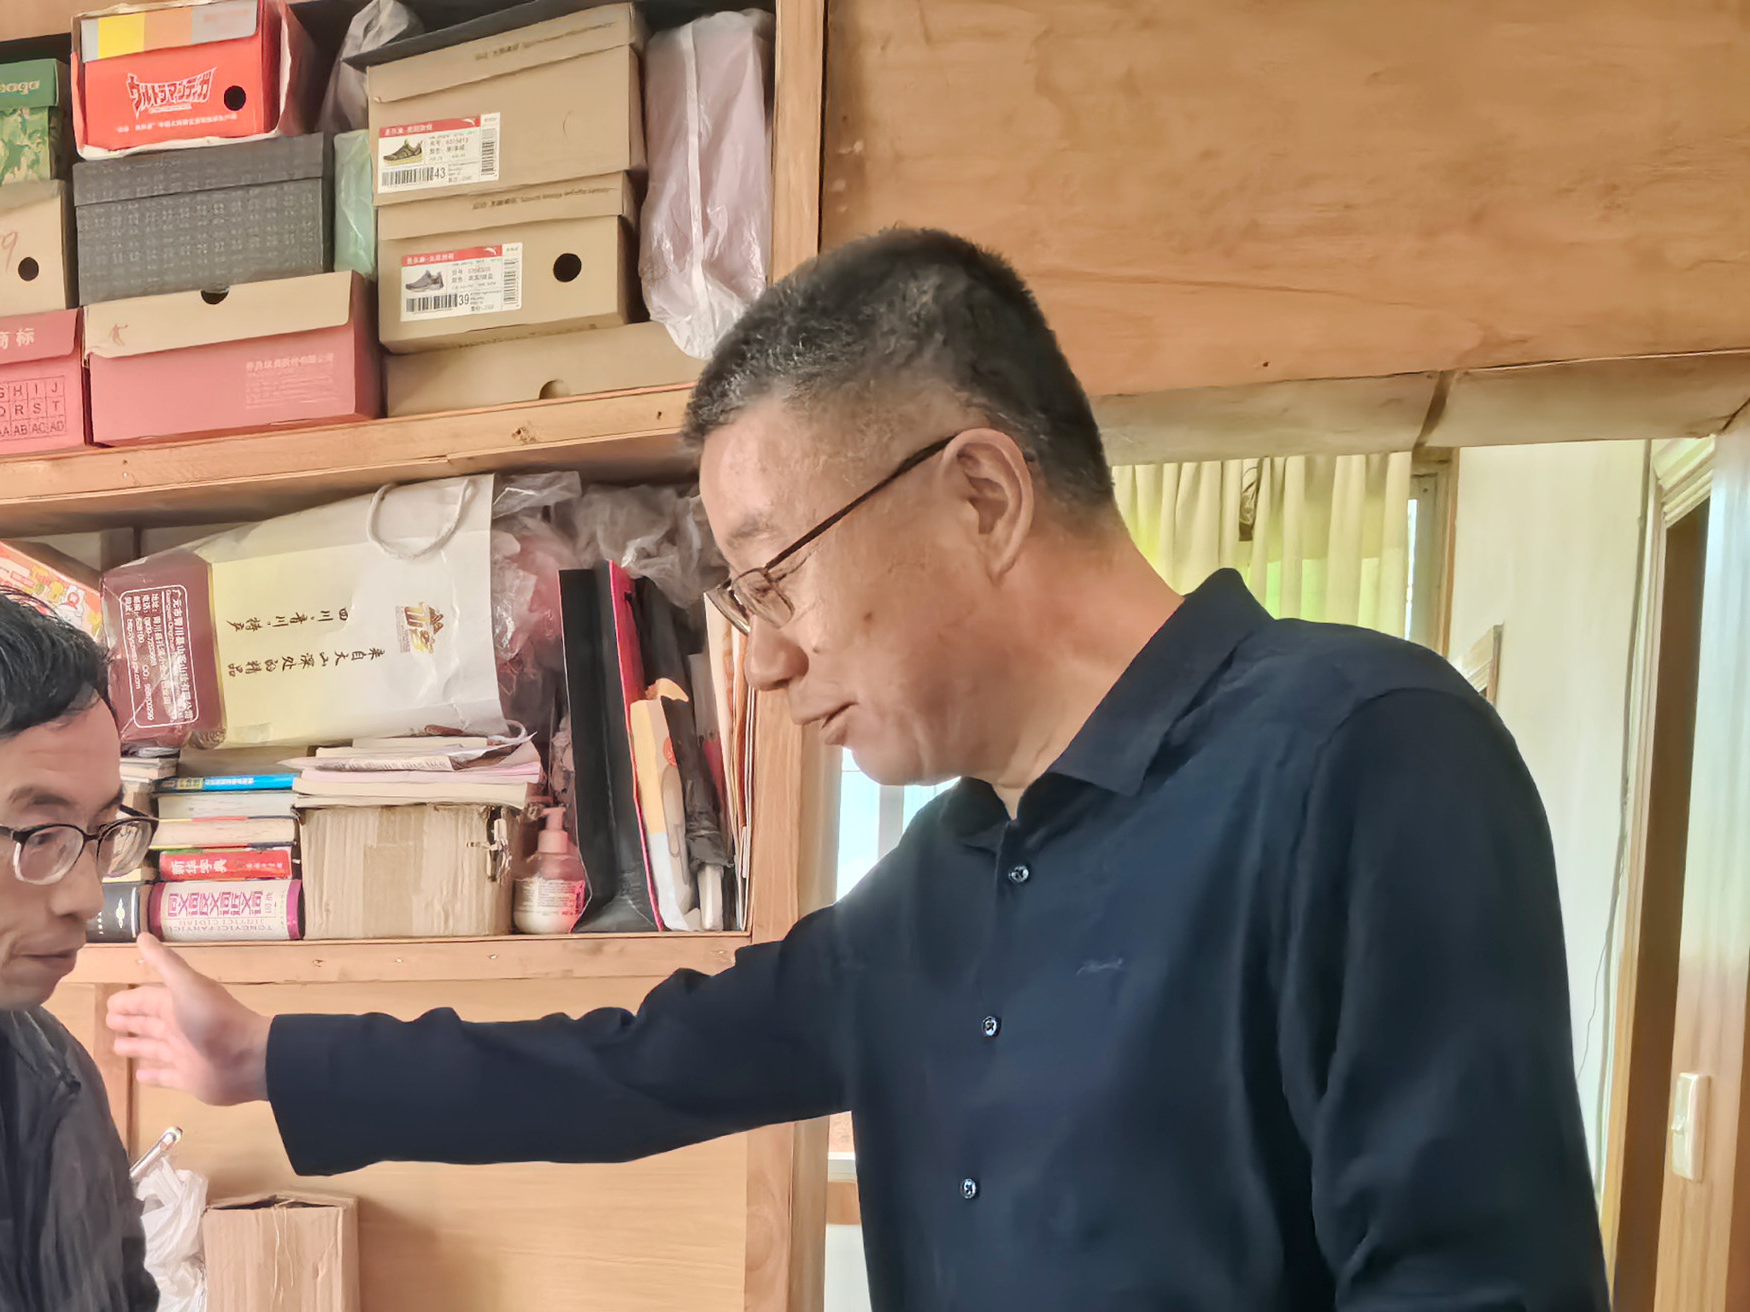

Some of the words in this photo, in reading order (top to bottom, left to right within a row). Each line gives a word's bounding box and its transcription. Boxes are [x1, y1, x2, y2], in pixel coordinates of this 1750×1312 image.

[434, 167, 446, 179] 43
[458, 294, 470, 305] 39
[13, 385, 23, 397] H
[51, 381, 58, 393] J
[14, 404, 24, 415] R
[33, 402, 42, 414] S
[52, 400, 60, 412] T
[14, 424, 28, 436] AB
[32, 422, 45, 433] AC
[50, 421, 64, 431] AD
[228, 648, 385, 677] 来自大山深处的精品
[171, 859, 227, 875] 新华字典
